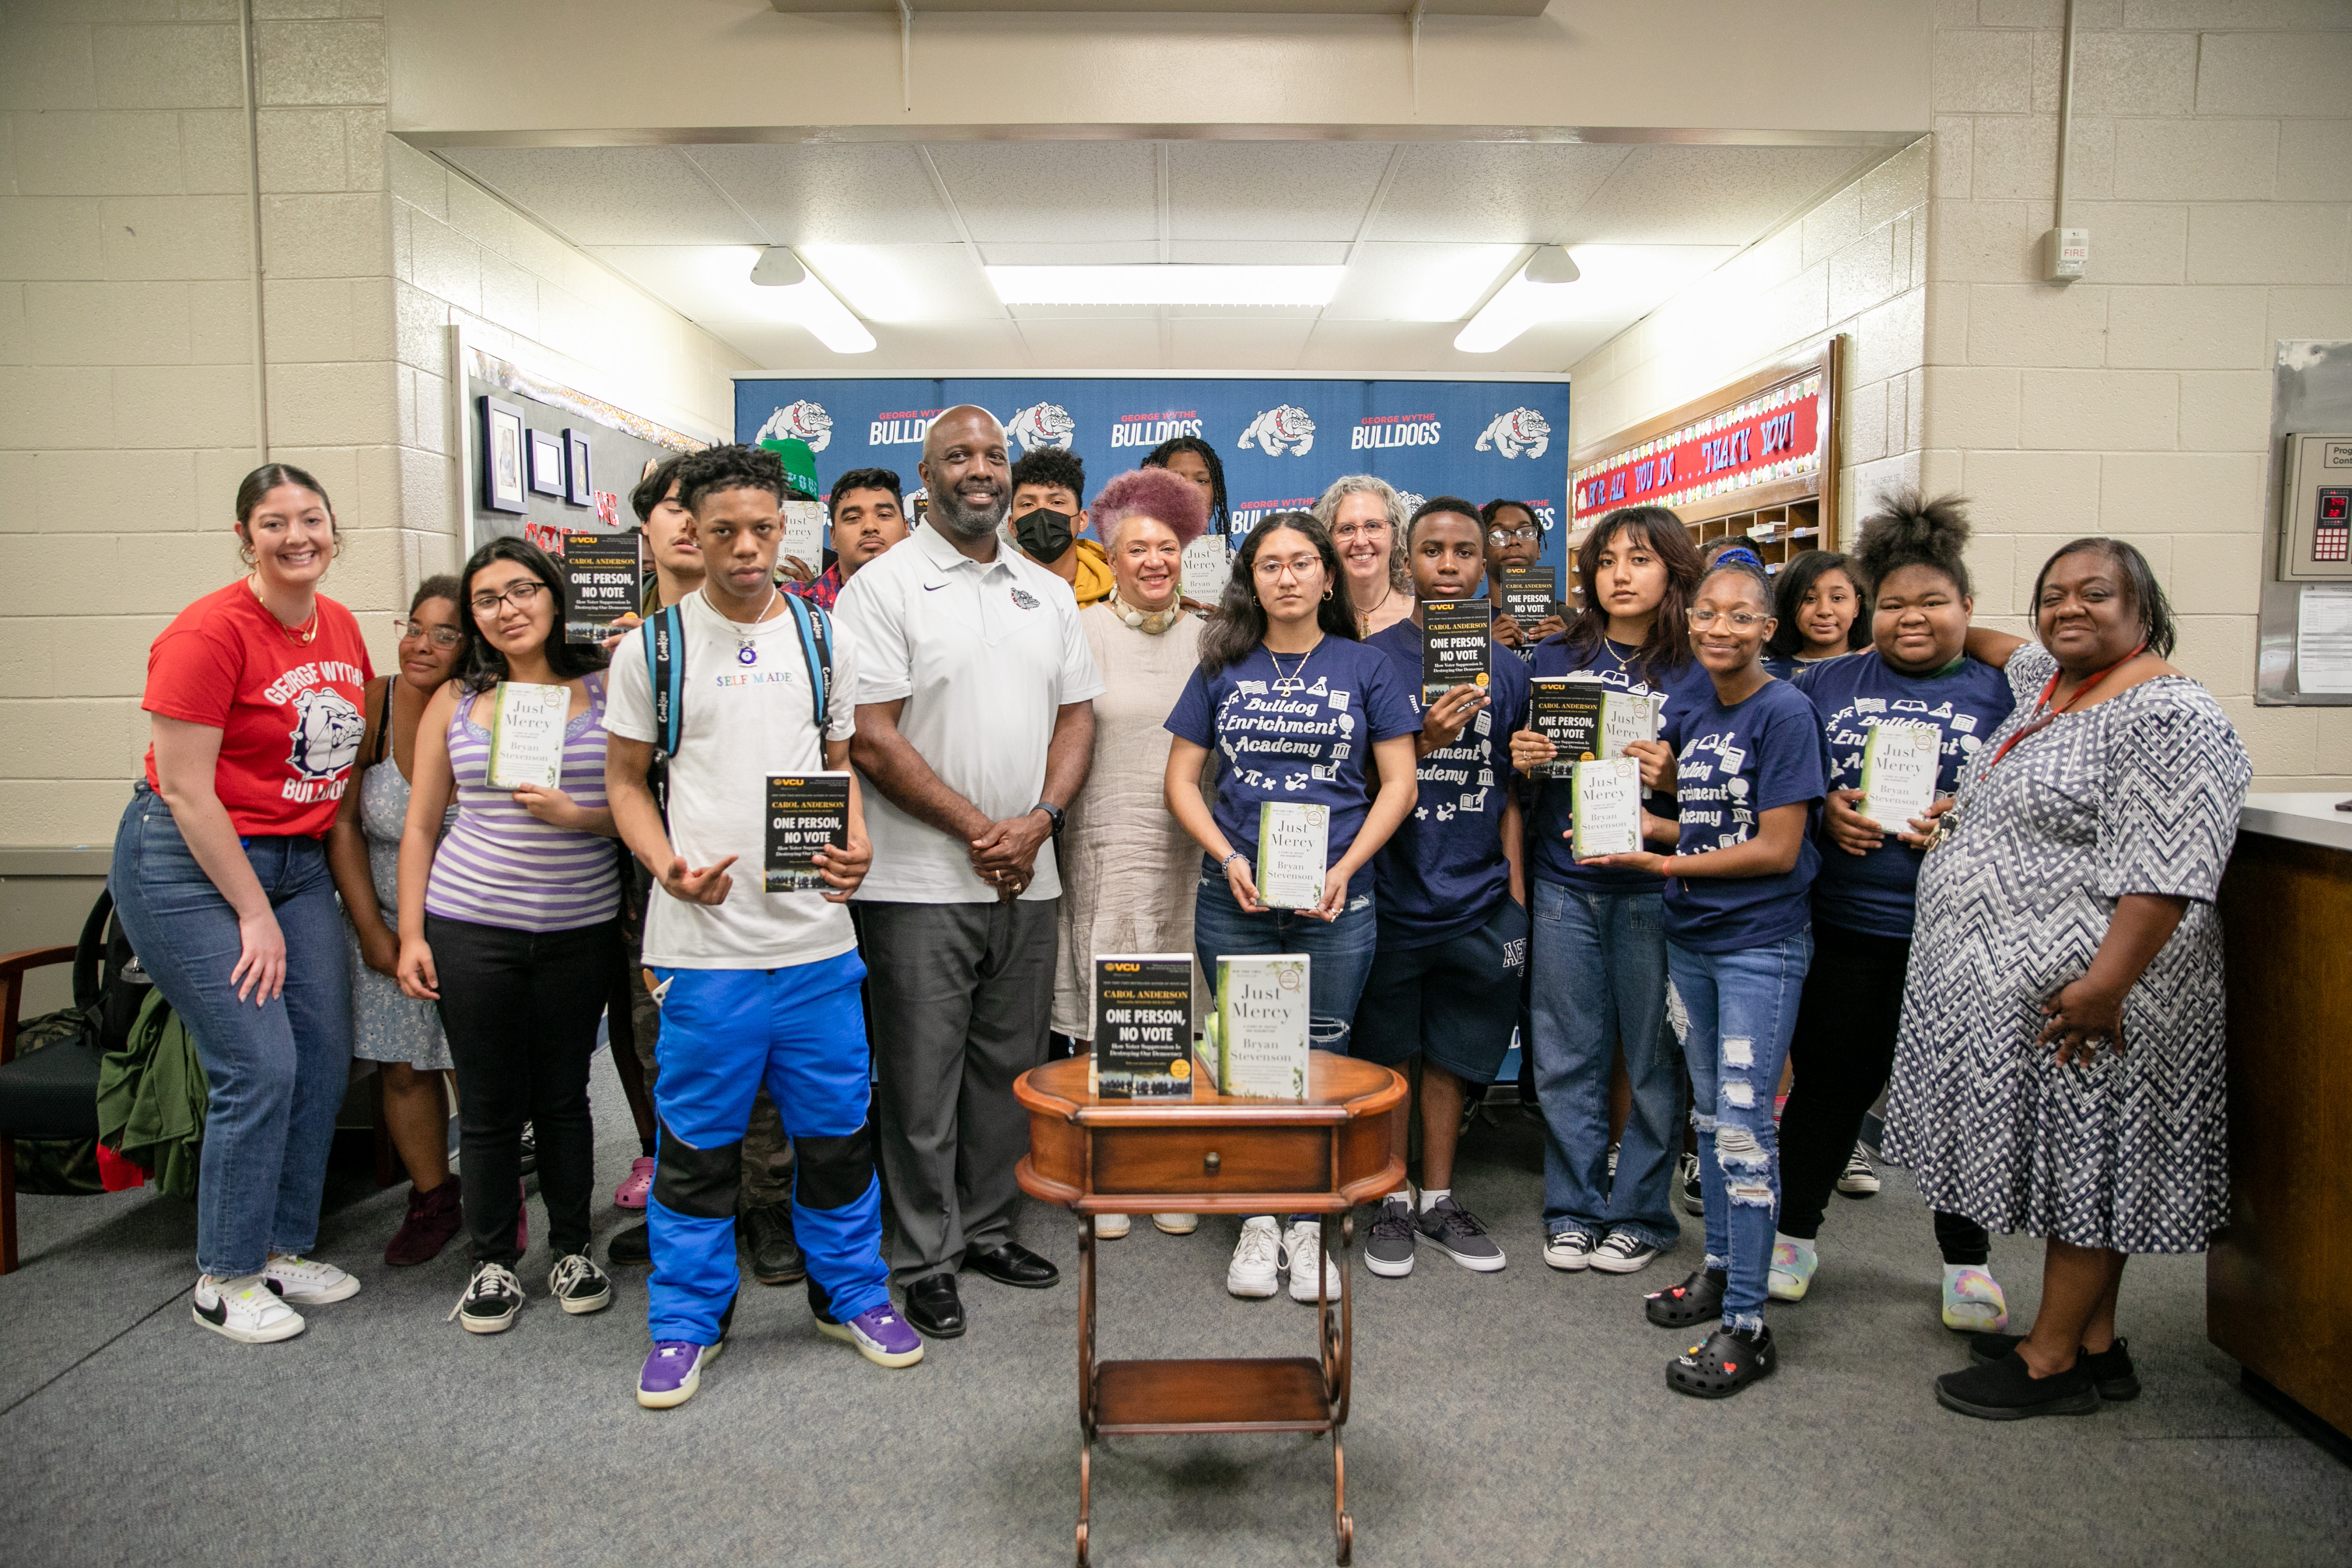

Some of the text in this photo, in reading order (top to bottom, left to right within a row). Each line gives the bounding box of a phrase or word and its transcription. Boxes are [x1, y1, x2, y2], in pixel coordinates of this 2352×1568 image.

[879, 409, 945, 420] GEORGE WYT
[1121, 411, 1196, 422] GEORGE WYTHE
[1361, 416, 1399, 425] GEORGE
[1111, 419, 1203, 447] BULLDOGS
[1351, 422, 1441, 449] BULLDOGS
[1610, 472, 1626, 501] ALL
[1635, 461, 1654, 493] YOU
[1760, 411, 1795, 456] YOU!
[1240, 497, 1315, 509] GEORGE WYTHE
[1188, 549, 1211, 559] Just
[1183, 560, 1217, 571] Mercy
[571, 573, 634, 585] ONE PERSON,
[581, 587, 624, 597] NO VOTE
[1523, 595, 1551, 603] PERSON,
[809, 611, 822, 639] Cookies
[658, 630, 669, 661] Cookies
[1431, 637, 1486, 648] ONE PERSON,
[1441, 650, 1477, 661] NO VOTE
[753, 672, 792, 683] MADE
[822, 667, 831, 698] Cookies
[264, 663, 320, 705] GEORGE
[513, 700, 545, 714] Just
[658, 691, 668, 723] Cookies
[1244, 698, 1319, 716] Bulldog
[504, 714, 552, 733] Mercy
[1539, 716, 1595, 728] ONE PERSON,
[1611, 711, 1635, 725] Just
[1225, 715, 1337, 735] Enrichment
[1605, 723, 1642, 739] Mercy
[1547, 728, 1584, 738] NO VOTE
[511, 742, 539, 753] Bryan
[1235, 736, 1322, 757] Academy
[1883, 743, 1916, 758] Just
[499, 750, 547, 762] Stevenson
[1874, 757, 1923, 776] Mercy
[1416, 764, 1469, 785] ademy
[1589, 777, 1619, 787] Just
[1582, 790, 1626, 801] Mercy
[1881, 784, 1909, 796] Bryan
[1869, 793, 1918, 805] Stevenson
[773, 817, 842, 830] ONE PERSON,
[1591, 814, 1617, 822] Bryan
[1278, 820, 1309, 833] Just
[1582, 822, 1626, 831] Stevenson
[784, 832, 831, 843] NO VOTE
[1270, 833, 1316, 851] Mercy
[1278, 861, 1304, 872] Bryan
[1267, 870, 1313, 880] Stevenson
[1114, 964, 1140, 972] VCU
[1241, 984, 1281, 1000] Just
[1106, 1009, 1186, 1026] ONE PERSON,
[1233, 1002, 1291, 1024] Mercy
[1120, 1027, 1173, 1041] NO VOTE
[1244, 1038, 1278, 1052] Bryan
[1230, 1051, 1291, 1061] Stevenson
